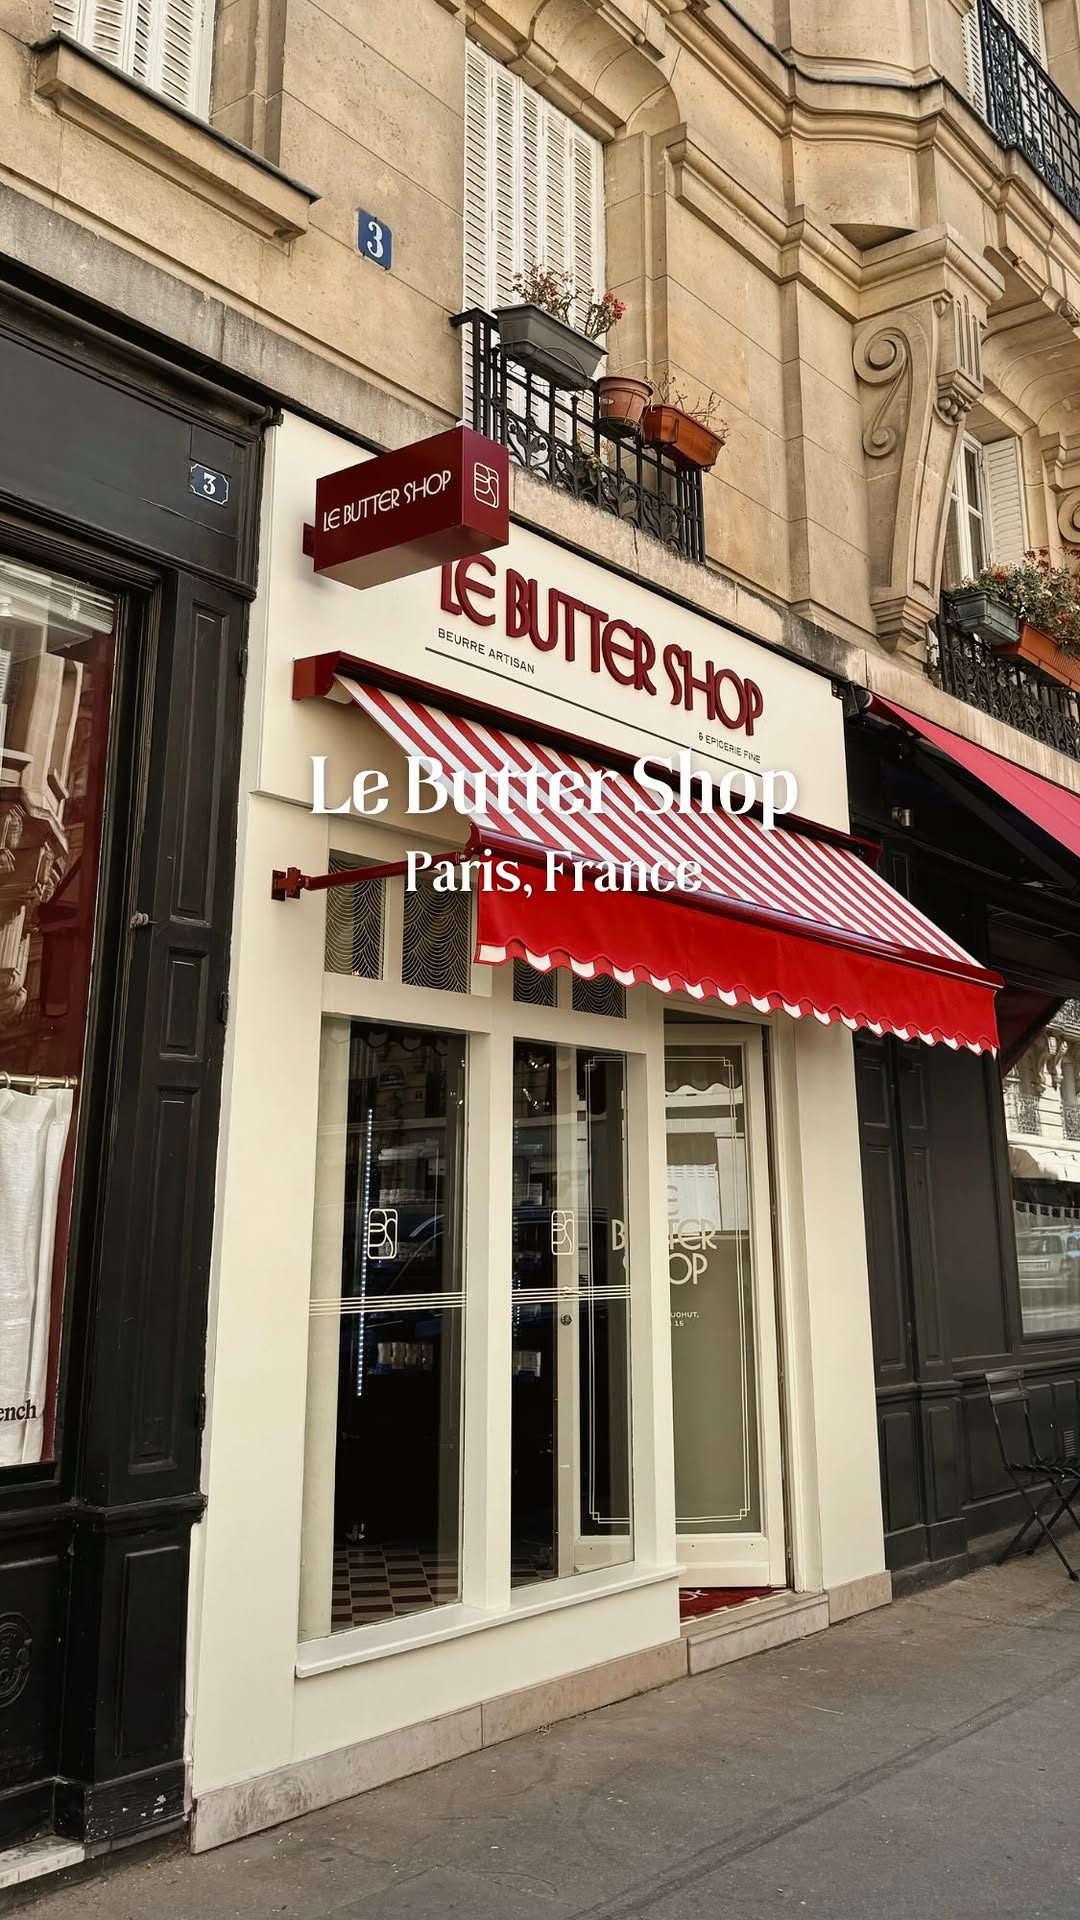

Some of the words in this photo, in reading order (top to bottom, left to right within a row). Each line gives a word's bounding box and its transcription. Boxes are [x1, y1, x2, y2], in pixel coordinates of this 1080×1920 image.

[367, 220, 383, 258] 3
[203, 472, 216, 495] 3
[323, 508, 341, 532] LE
[343, 488, 400, 525] BUTTER
[403, 470, 452, 504] SHOP
[438, 627, 485, 655] BEURRE
[488, 649, 535, 675] ARTISAN
[441, 553, 496, 626] LE
[506, 568, 657, 696] BUTTER
[663, 644, 764, 736] SHOP
[705, 734, 742, 757] EPICERIE
[743, 749, 761, 764] FINE
[611, 1218, 718, 1251] BTER
